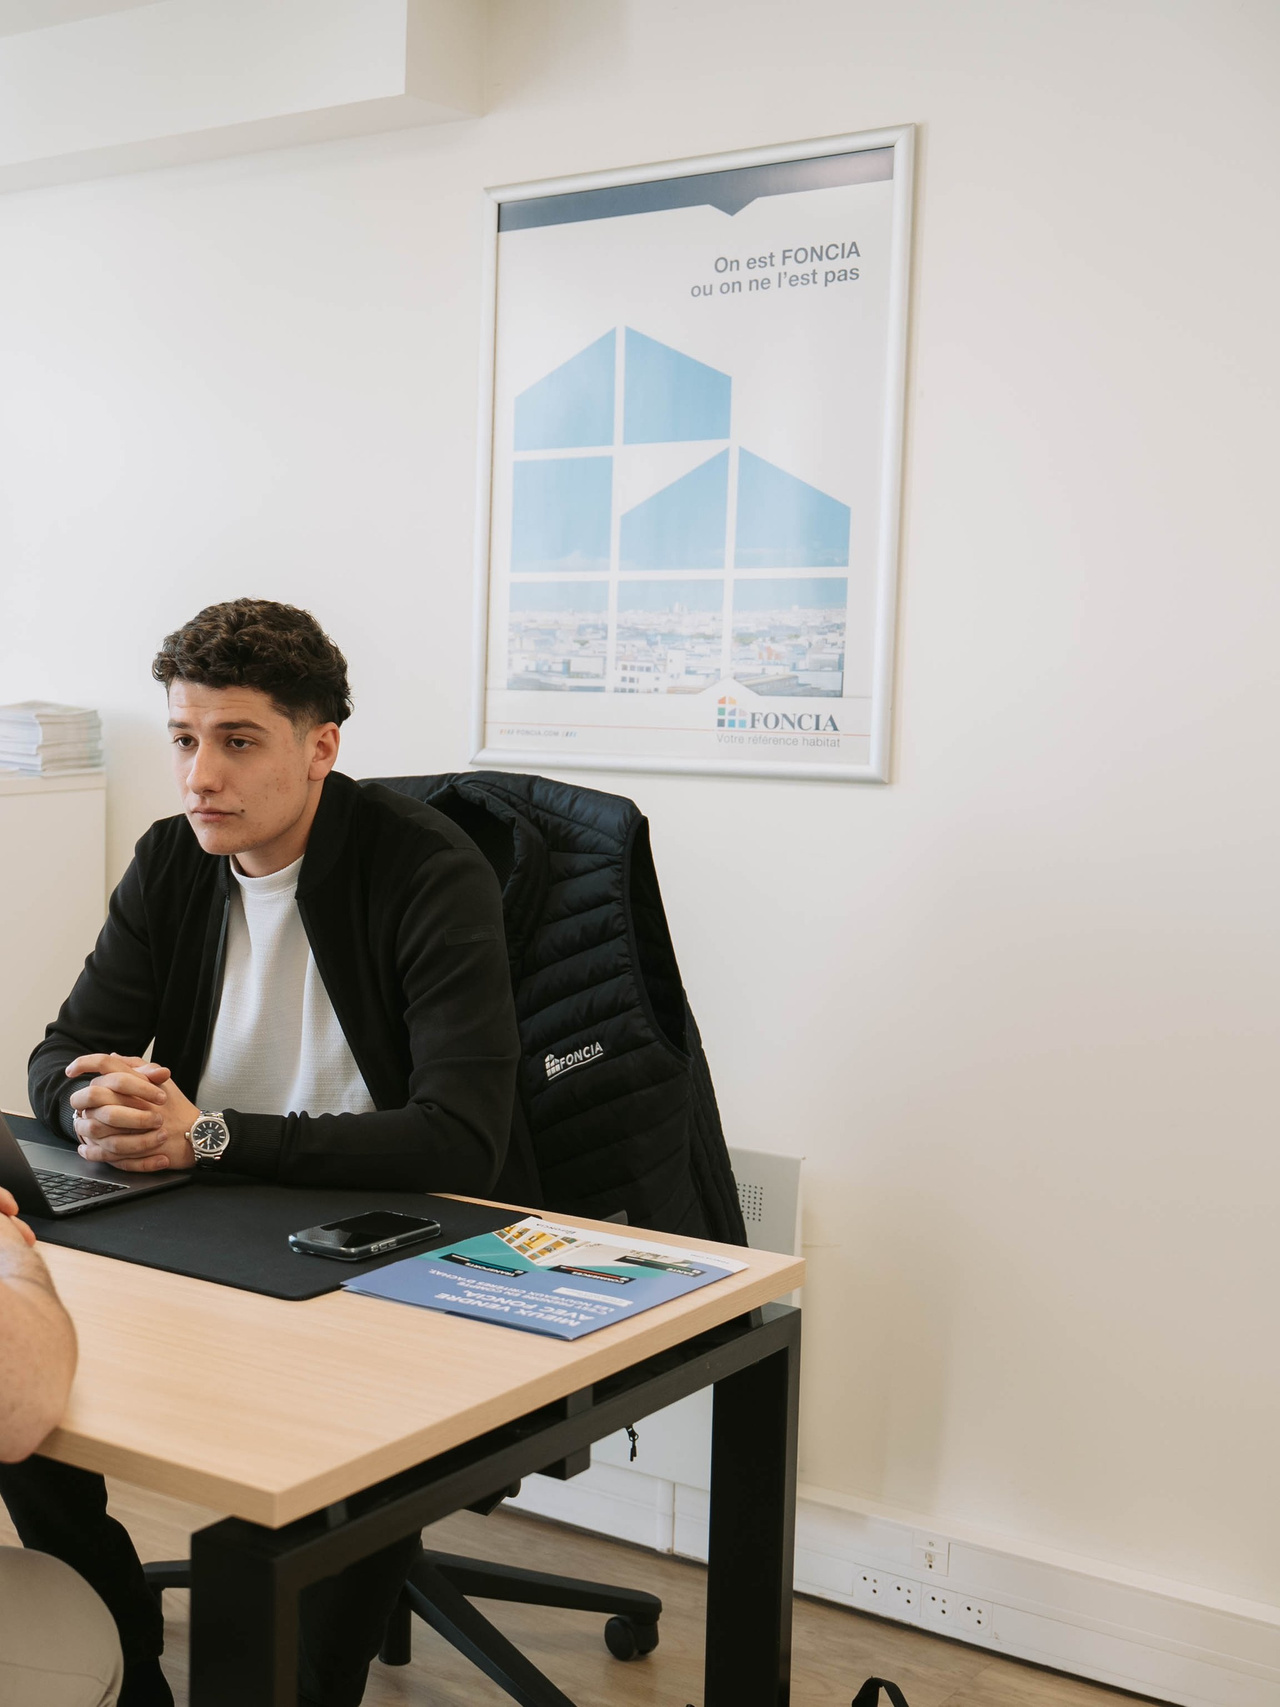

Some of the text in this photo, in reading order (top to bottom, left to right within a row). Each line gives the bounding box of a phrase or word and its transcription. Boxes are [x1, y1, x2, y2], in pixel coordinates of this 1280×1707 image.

[714, 241, 861, 274] On est FONCIA
[690, 267, 860, 297] ou on ne l'est pas
[750, 712, 840, 732] FONCIA
[716, 732, 840, 748] Votre référence habitat
[560, 1041, 603, 1069] FONCIA
[465, 1262, 516, 1277] TRANSPORTS
[434, 1292, 582, 1327] MIEUX VENDRE
[463, 1289, 538, 1310] FONCIA,
[540, 1306, 595, 1321] AVEC
